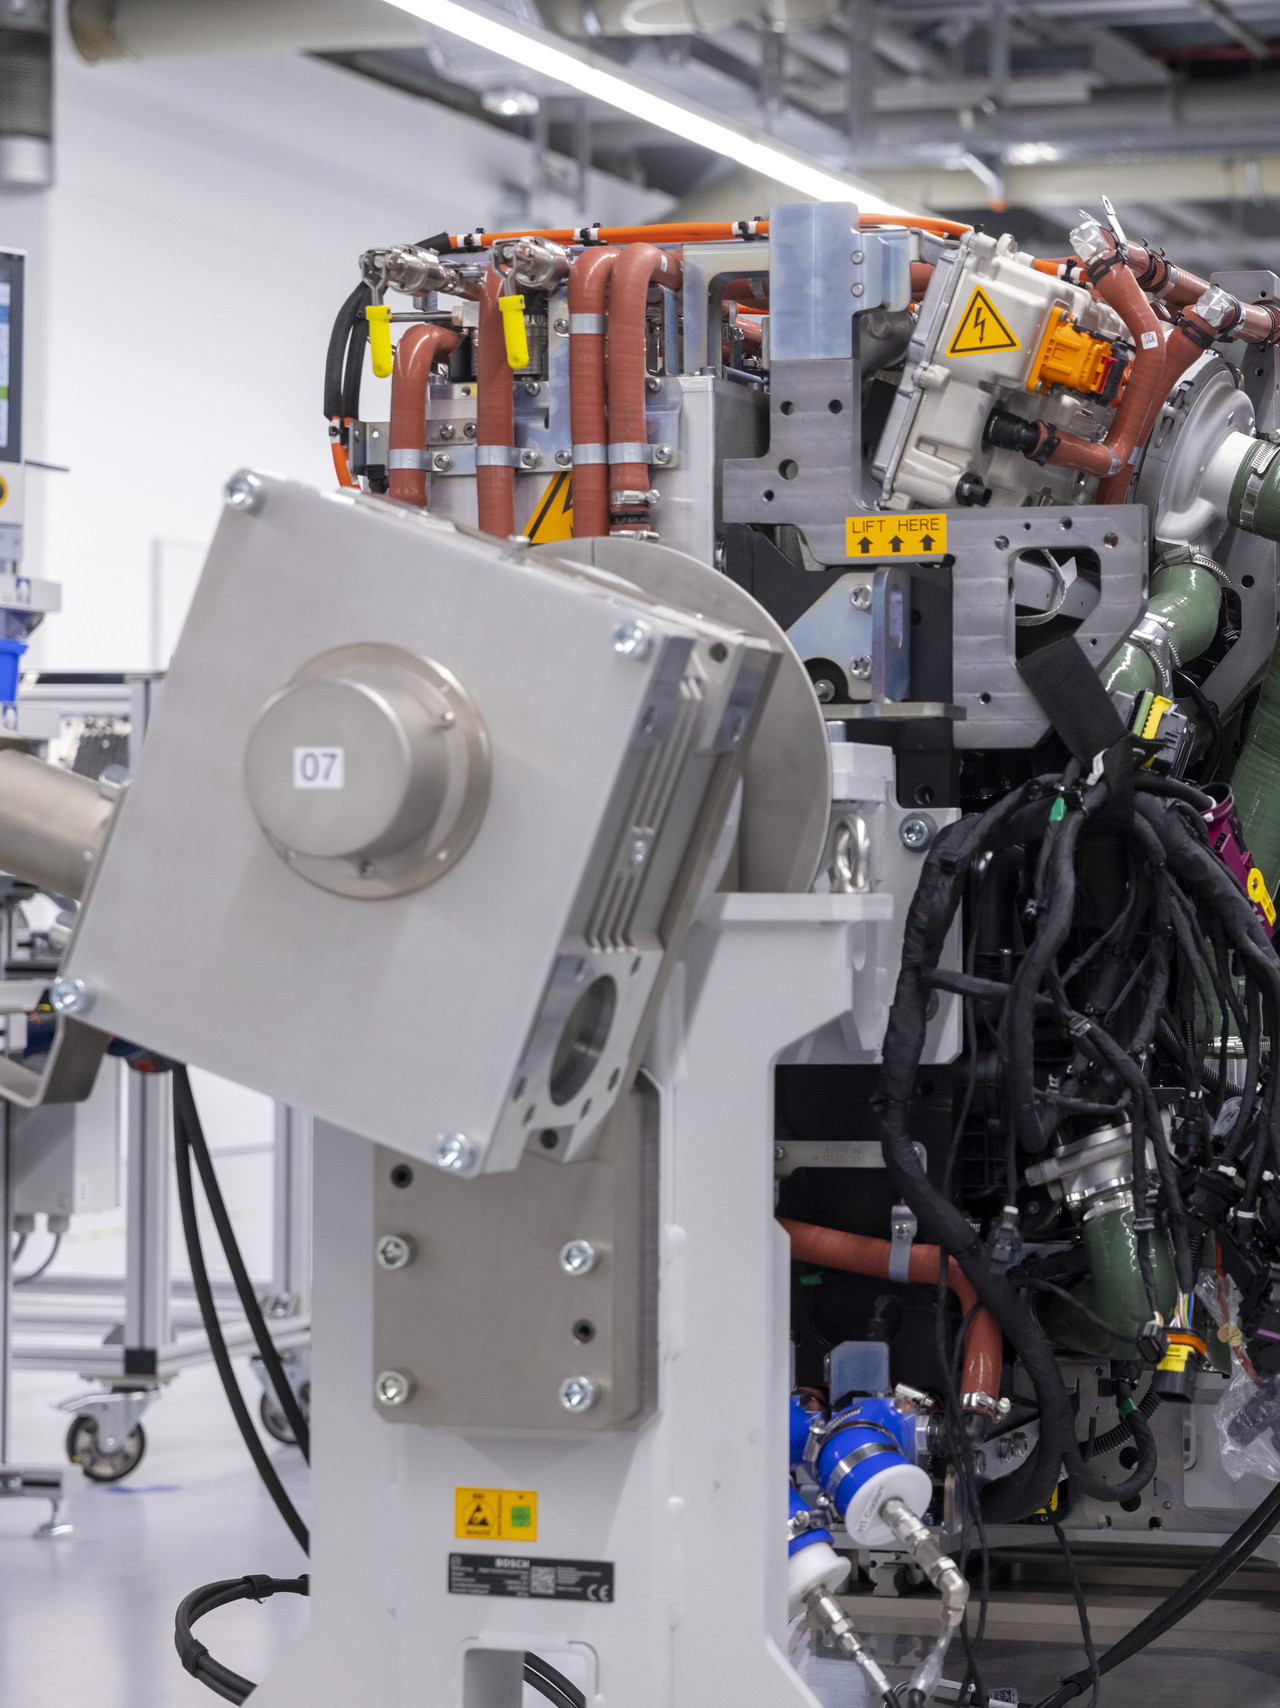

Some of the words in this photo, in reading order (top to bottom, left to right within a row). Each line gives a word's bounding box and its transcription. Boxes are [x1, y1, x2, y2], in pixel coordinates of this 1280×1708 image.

[852, 520, 886, 533] LIFT
[898, 518, 940, 531] HERE
[300, 752, 338, 782] 07
[495, 1558, 530, 1568] BOSCH
